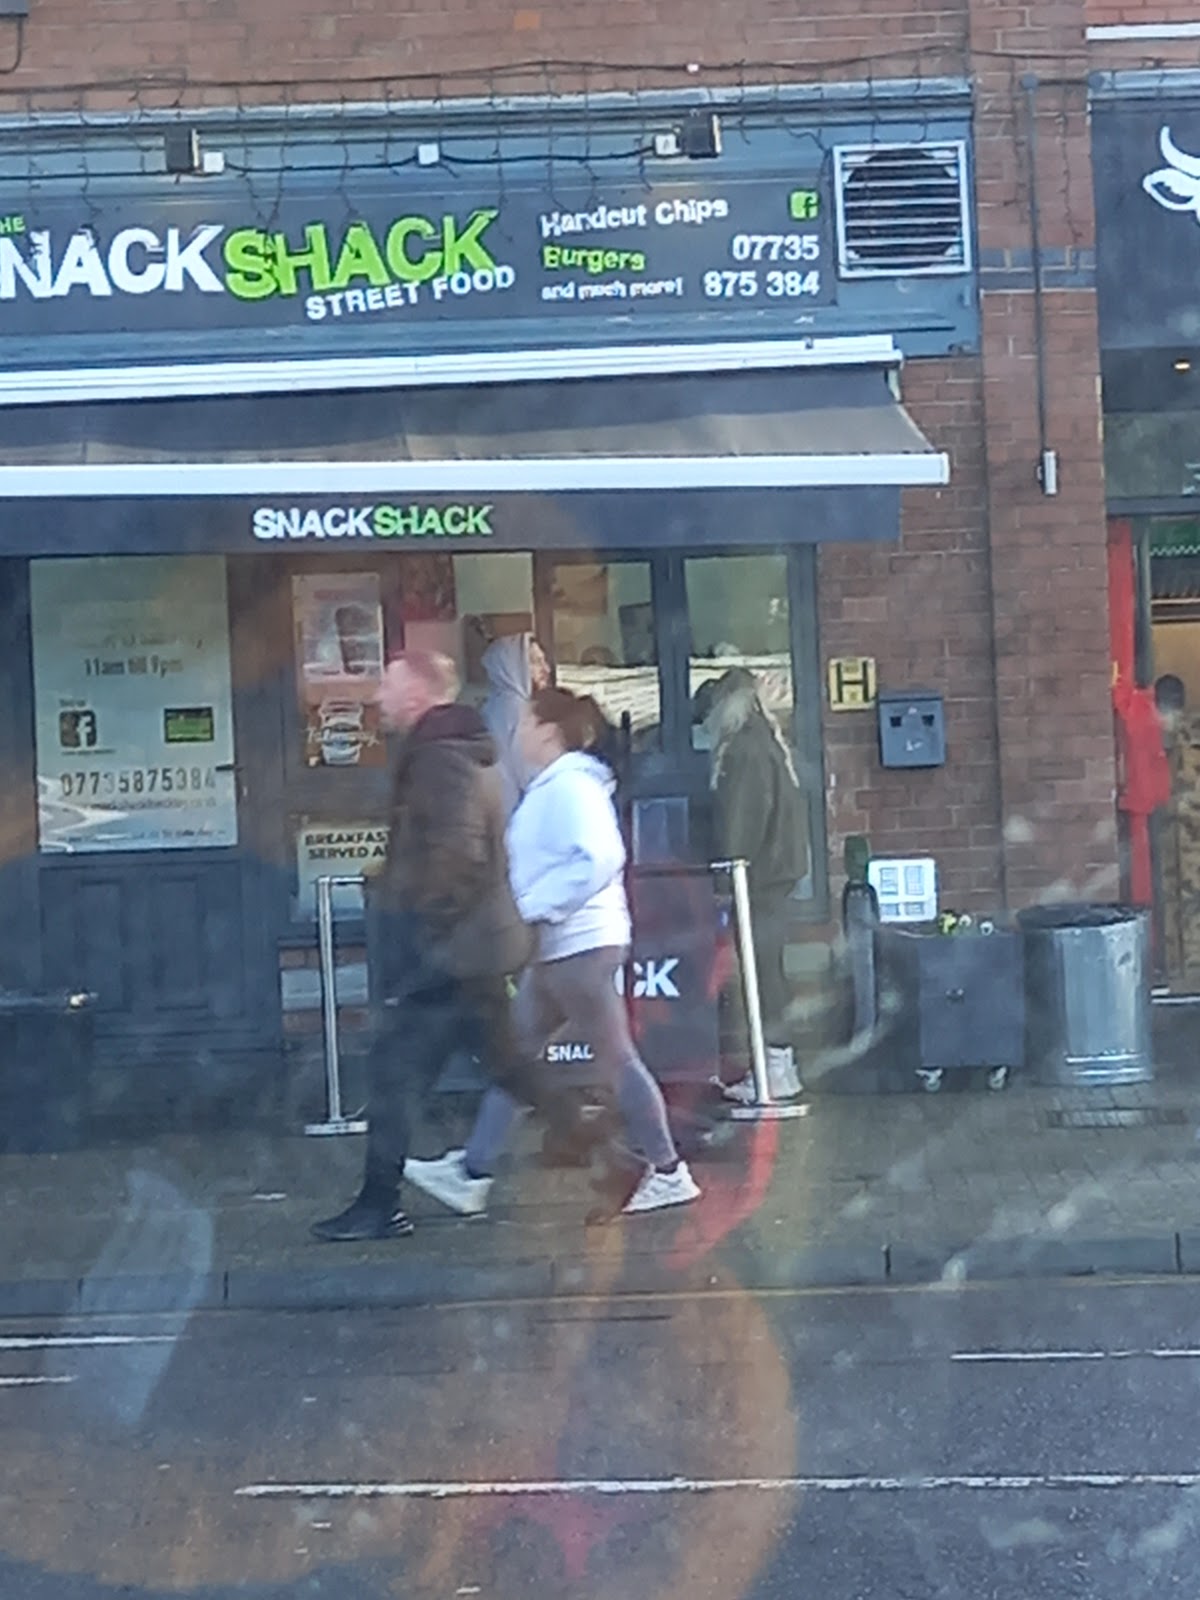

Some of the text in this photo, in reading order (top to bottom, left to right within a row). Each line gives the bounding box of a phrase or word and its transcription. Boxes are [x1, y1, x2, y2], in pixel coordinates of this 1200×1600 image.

[541, 198, 728, 238] Handcut Chips
[543, 245, 645, 274] Burgers
[732, 234, 820, 261] 07735
[305, 265, 516, 320] STREET FOOD
[542, 281, 576, 300] and
[578, 280, 627, 299] much
[703, 270, 820, 297] 875 384
[60, 766, 216, 797] 07735875384
[308, 846, 369, 860] SERVED
